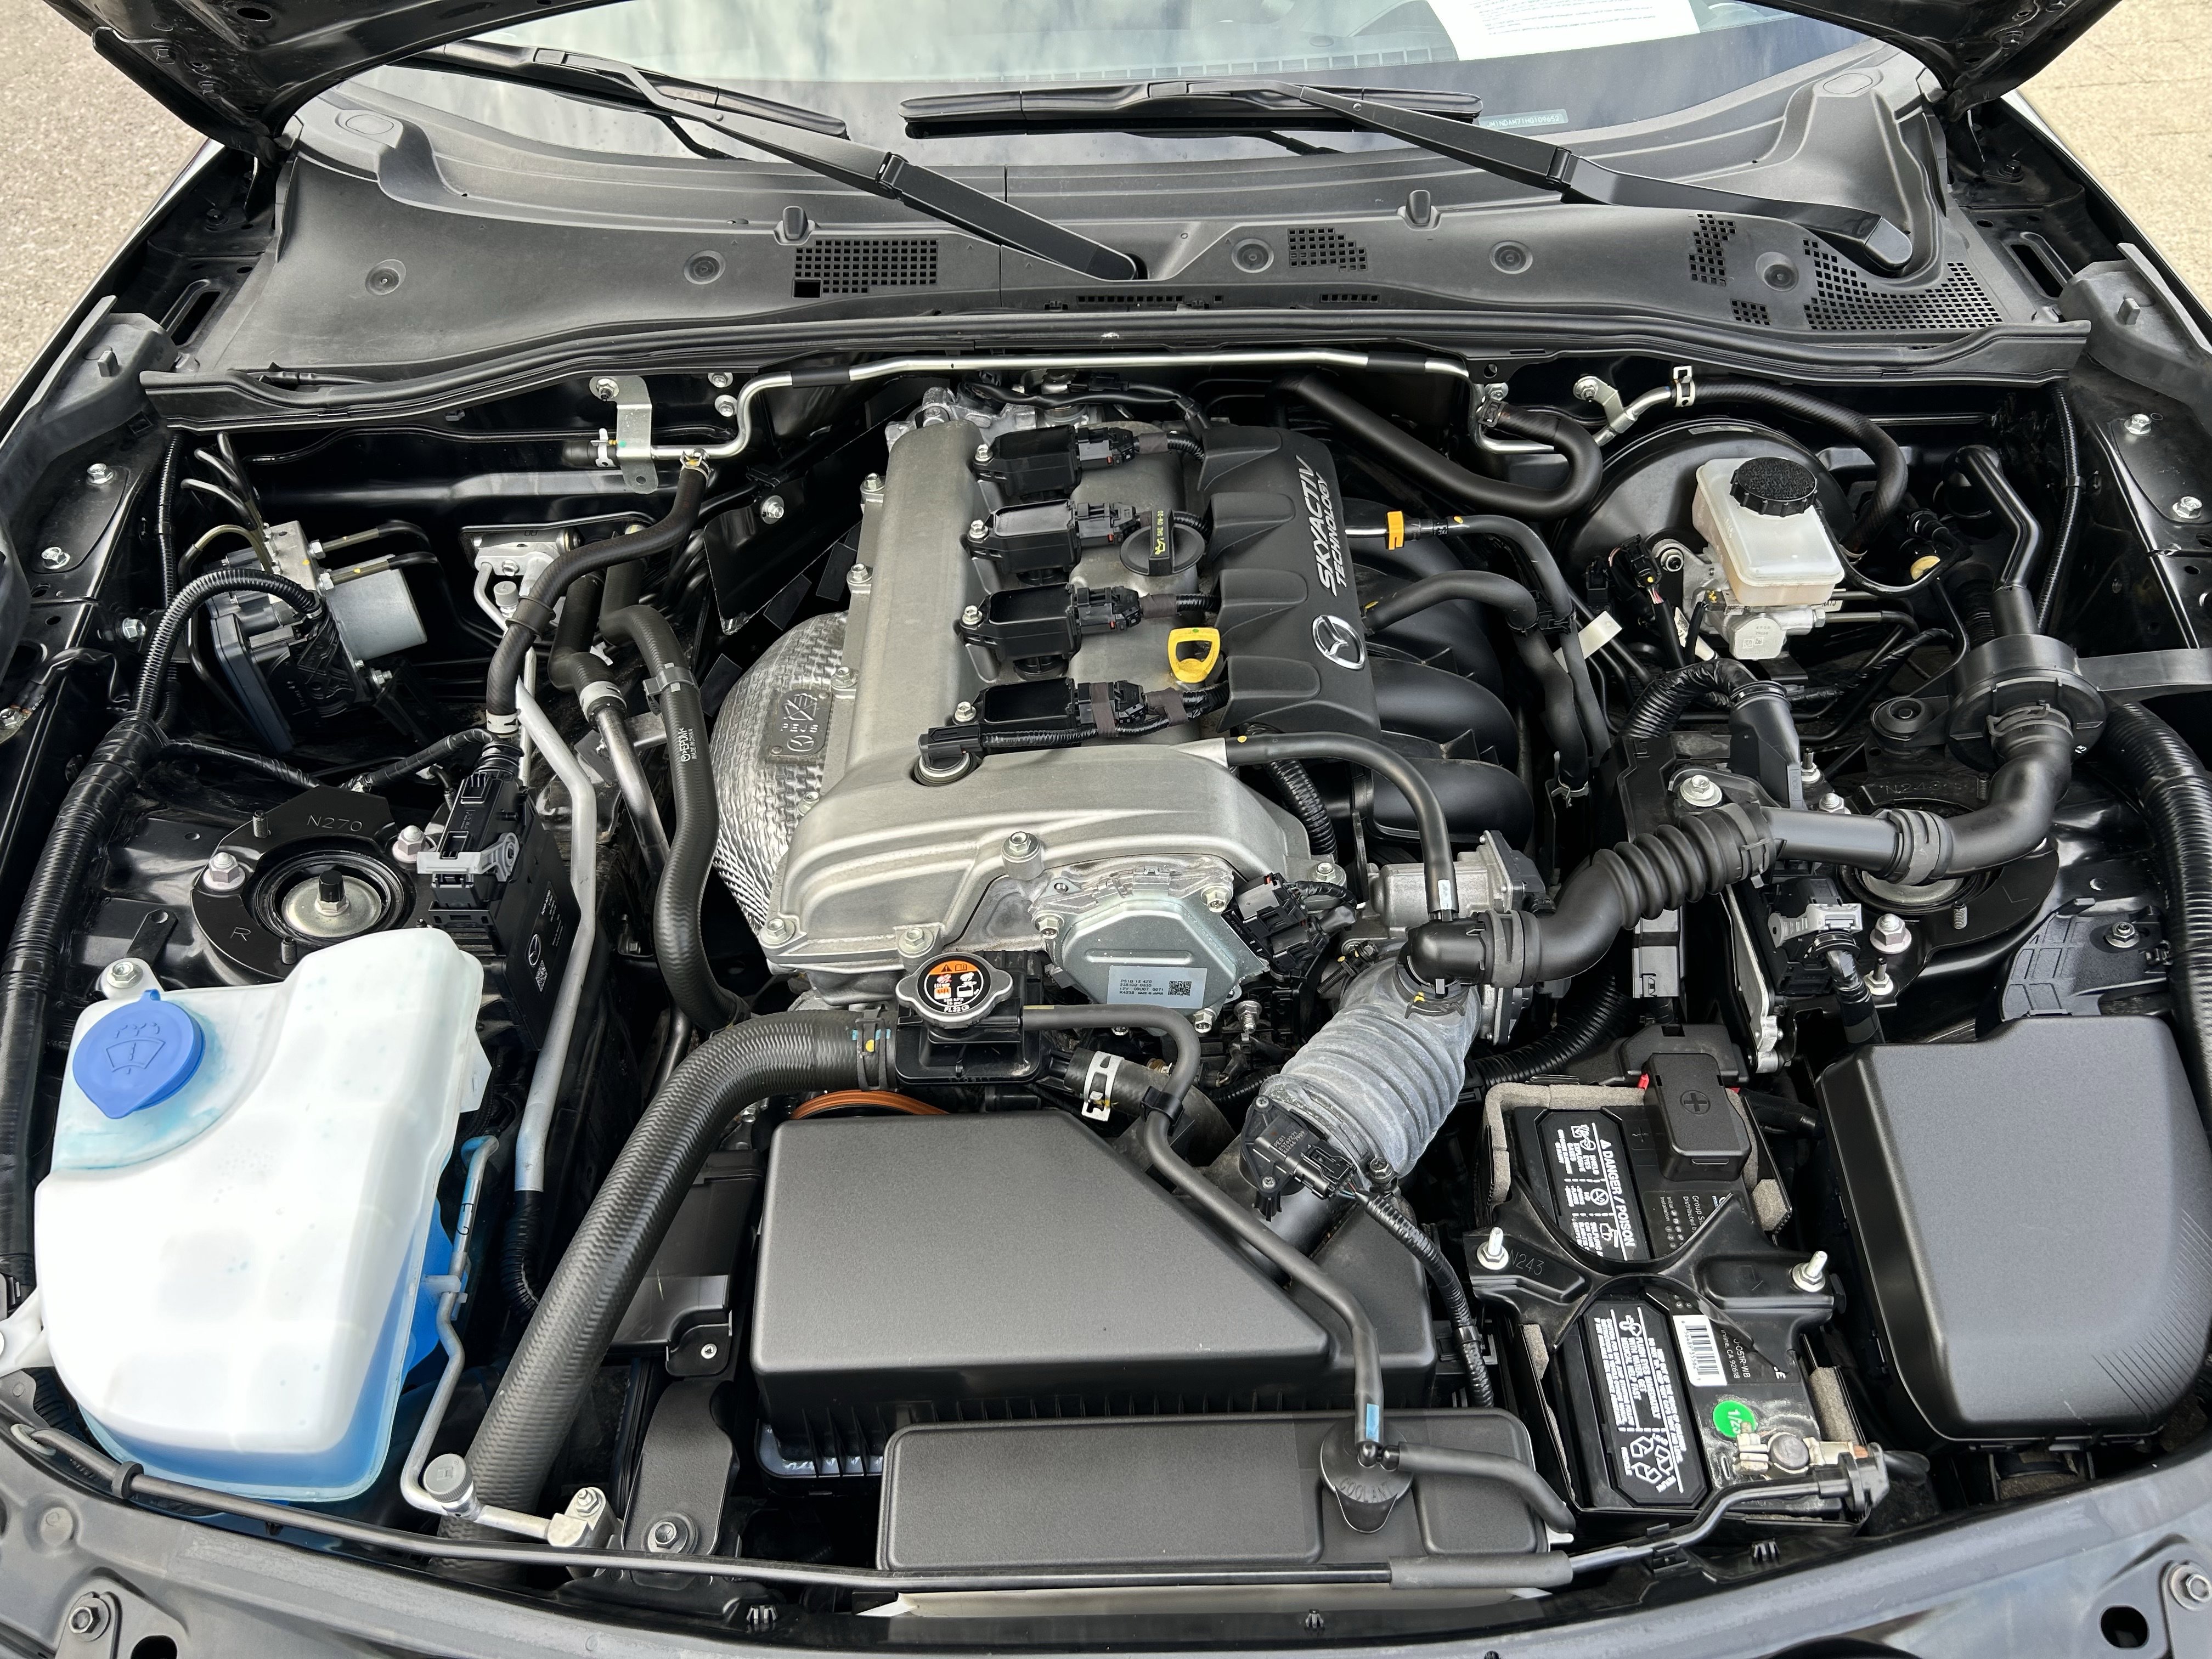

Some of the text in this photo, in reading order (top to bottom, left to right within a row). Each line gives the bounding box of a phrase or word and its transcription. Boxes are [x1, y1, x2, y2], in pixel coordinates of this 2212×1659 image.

[1296, 455, 1338, 597] SKYACTIV
[1324, 477, 1347, 588] TECHNOLOGY
[307, 815, 363, 832] N270
[230, 927, 251, 941] R
[1567, 1142, 1577, 1161] GASES
[1573, 1142, 1586, 1172] EXPLOSIVE
[1582, 1155, 1592, 1170] EYES
[1588, 1155, 1600, 1175] SHIELD
[1602, 1150, 1622, 1194] DANGER
[1616, 1205, 1635, 1247] POISON
[1683, 1196, 1696, 1225] Distributed
[1692, 1195, 1702, 1214] Group
[1589, 1222, 1602, 1251] SULFURIC
[1508, 1249, 1544, 1275] N243
[1627, 1337, 1638, 1354] WITH
[1637, 1379, 1646, 1392] GET
[1726, 1350, 1734, 1358] CA
[1620, 1337, 1641, 1401] MEDICAL HELP FAST
[1635, 1336, 1661, 1419] FLUSH EYES IMMEDIATELY
[1729, 1359, 1740, 1379] 92618
[1340, 1477, 1394, 1503] COOLANT
